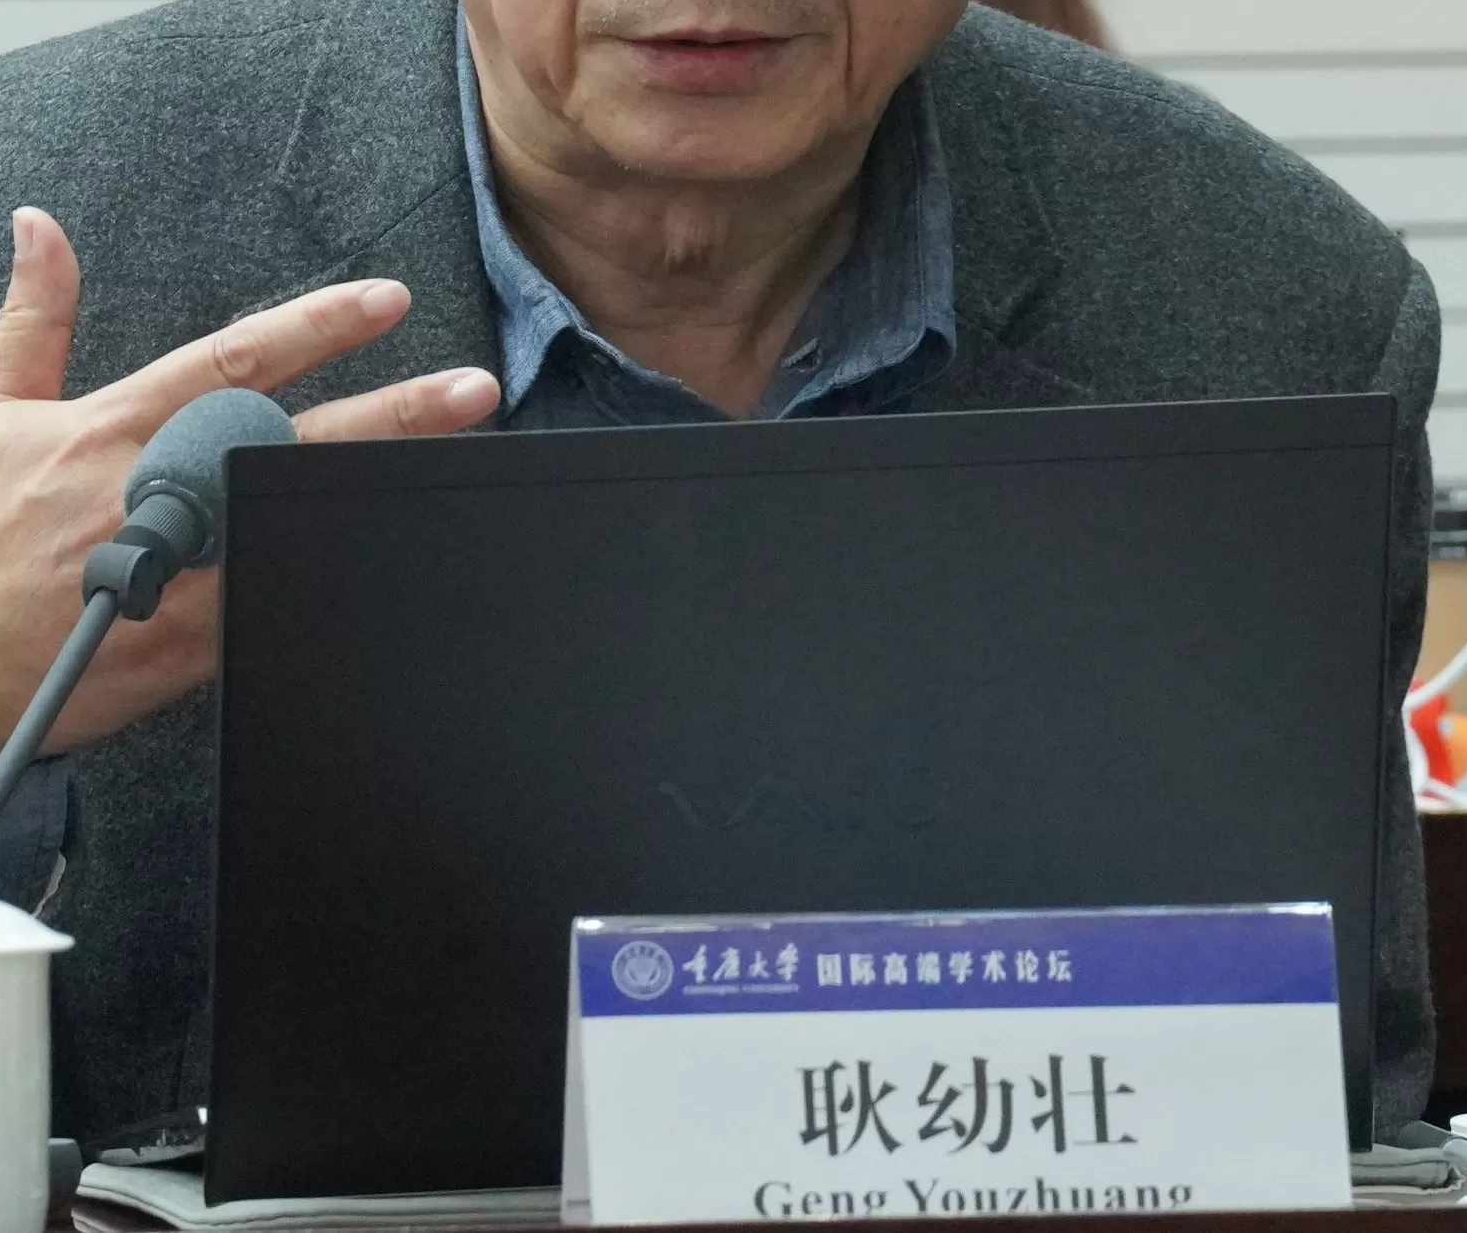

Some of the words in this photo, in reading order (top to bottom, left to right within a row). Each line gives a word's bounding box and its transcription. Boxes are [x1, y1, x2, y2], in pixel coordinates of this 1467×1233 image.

[817, 950, 1072, 987] 国际高端学术论坛
[796, 1053, 1139, 1157] 耿幼壮
[753, 1179, 888, 1218] Geng
[904, 1176, 1194, 1213] Youzhuang
